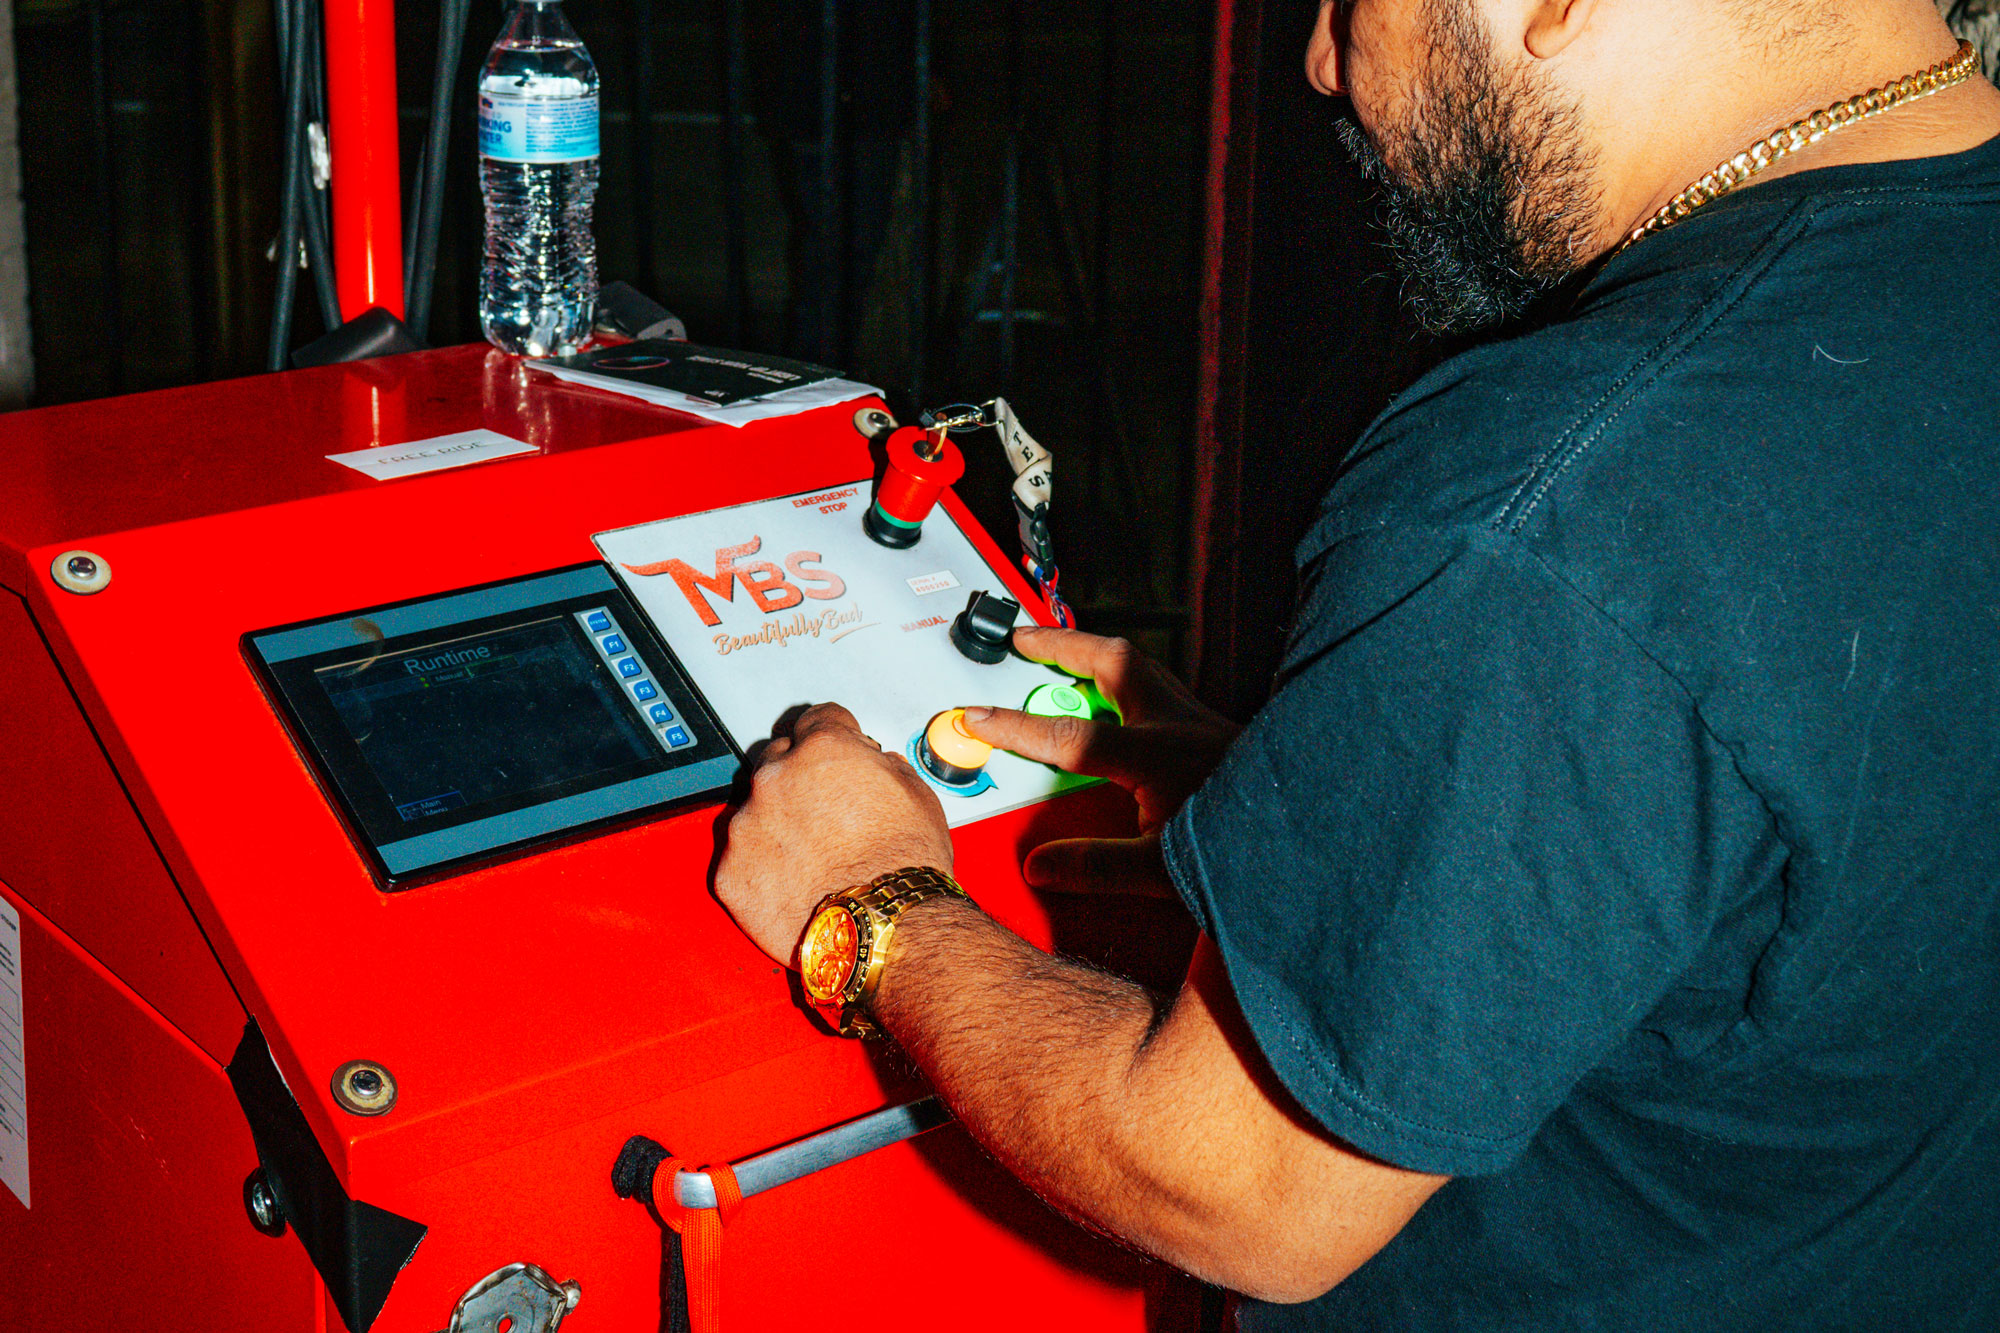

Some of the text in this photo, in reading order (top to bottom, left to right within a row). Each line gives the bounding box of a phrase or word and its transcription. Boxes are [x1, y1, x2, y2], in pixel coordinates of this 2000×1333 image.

[377, 441, 487, 465] FREE RIDE
[791, 487, 859, 509] EMERGENCY
[818, 501, 848, 515] STOP
[620, 534, 847, 627] MBS
[901, 615, 948, 633] MANUAL
[712, 611, 823, 656] Beautifully
[608, 641, 620, 649] F1
[404, 645, 491, 675] Runtime
[623, 663, 635, 672] F2
[639, 686, 651, 695] F3
[655, 709, 667, 718] F4
[671, 732, 683, 741] F5
